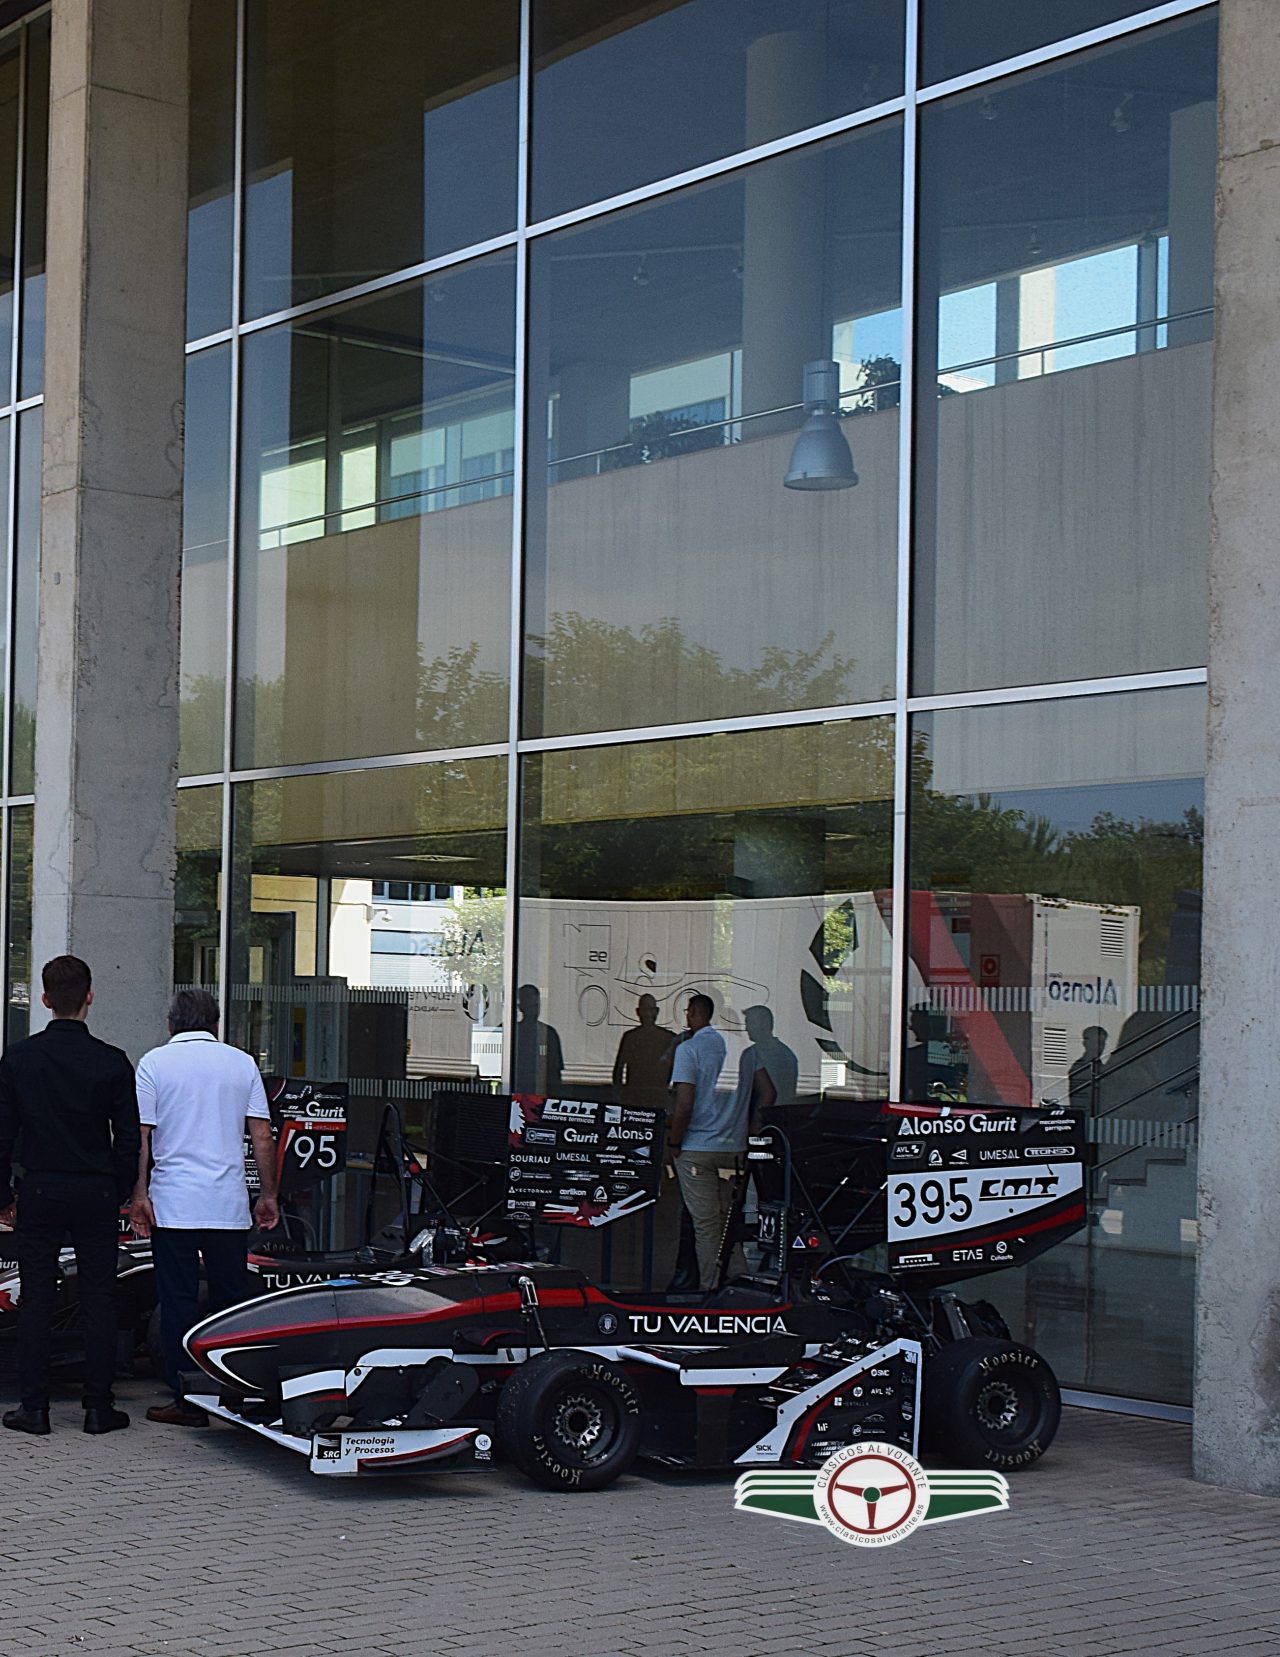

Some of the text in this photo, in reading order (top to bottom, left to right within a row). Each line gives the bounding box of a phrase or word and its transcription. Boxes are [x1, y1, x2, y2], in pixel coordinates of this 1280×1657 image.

[305, 1101, 345, 1118] Gurit
[541, 1114, 567, 1123] motores
[898, 1113, 1018, 1136] Alonso Gurit
[563, 1127, 599, 1144] Gurit
[606, 1126, 654, 1141] Alonso
[896, 1146, 910, 1154] AVL
[979, 1149, 1021, 1161] UMESAL
[509, 1154, 551, 1164] SOURIAU
[556, 1152, 591, 1163] UMESAL
[893, 1176, 973, 1228] 395
[952, 1250, 983, 1261] ETAS
[628, 1315, 788, 1334] TU VALENCIA
[979, 1349, 1039, 1376] Hoosier
[322, 1450, 340, 1459] SRG
[345, 1446, 395, 1456] y Procesos
[533, 1435, 583, 1484] Hoosier
